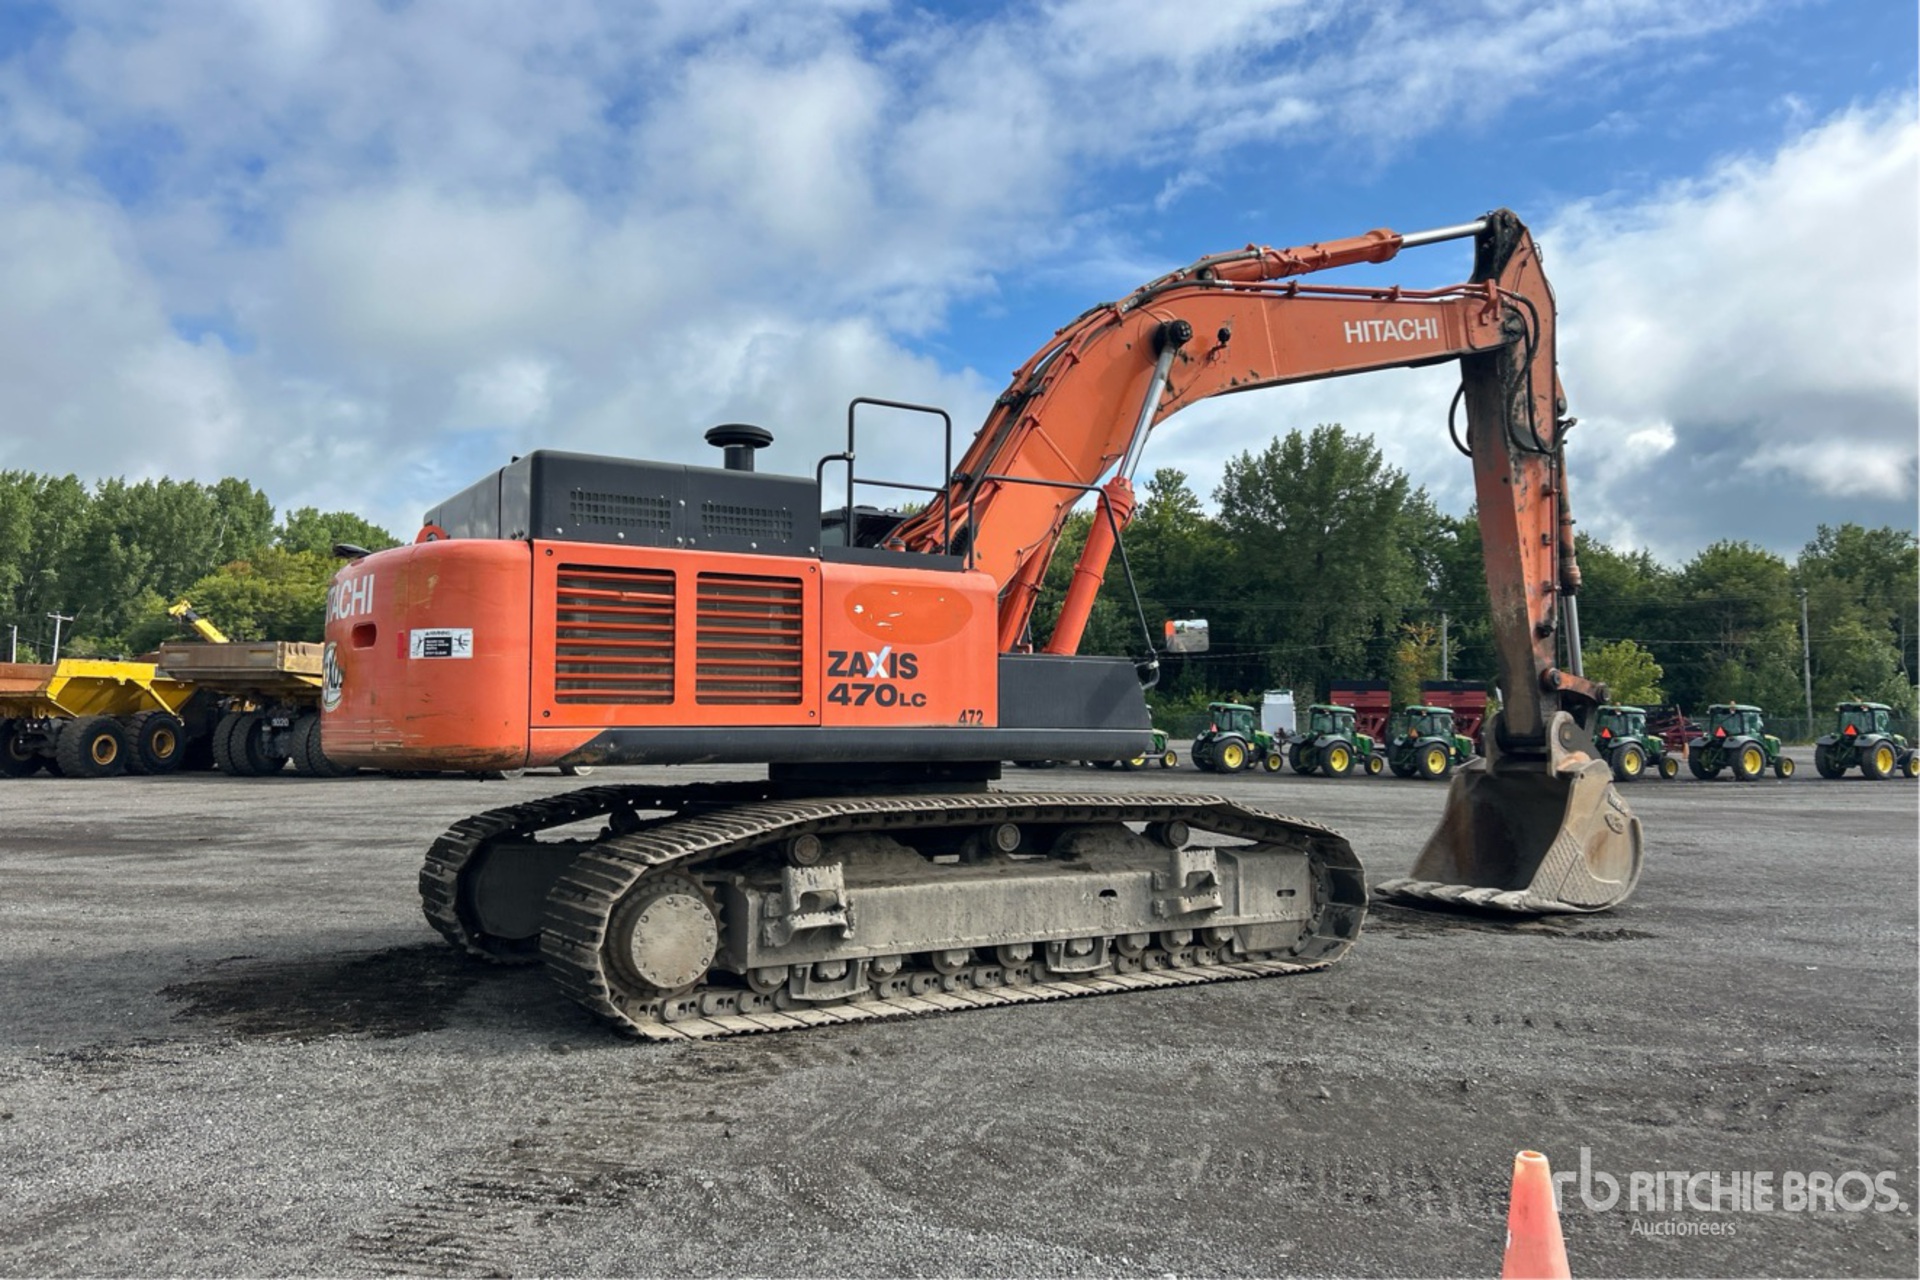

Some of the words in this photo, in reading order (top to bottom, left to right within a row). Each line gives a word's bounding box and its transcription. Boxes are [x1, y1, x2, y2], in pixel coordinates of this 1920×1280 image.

[1344, 317, 1439, 344] HITACHI
[827, 646, 918, 679] ZAXIS
[827, 683, 927, 707] 470LC
[958, 709, 984, 724] 472
